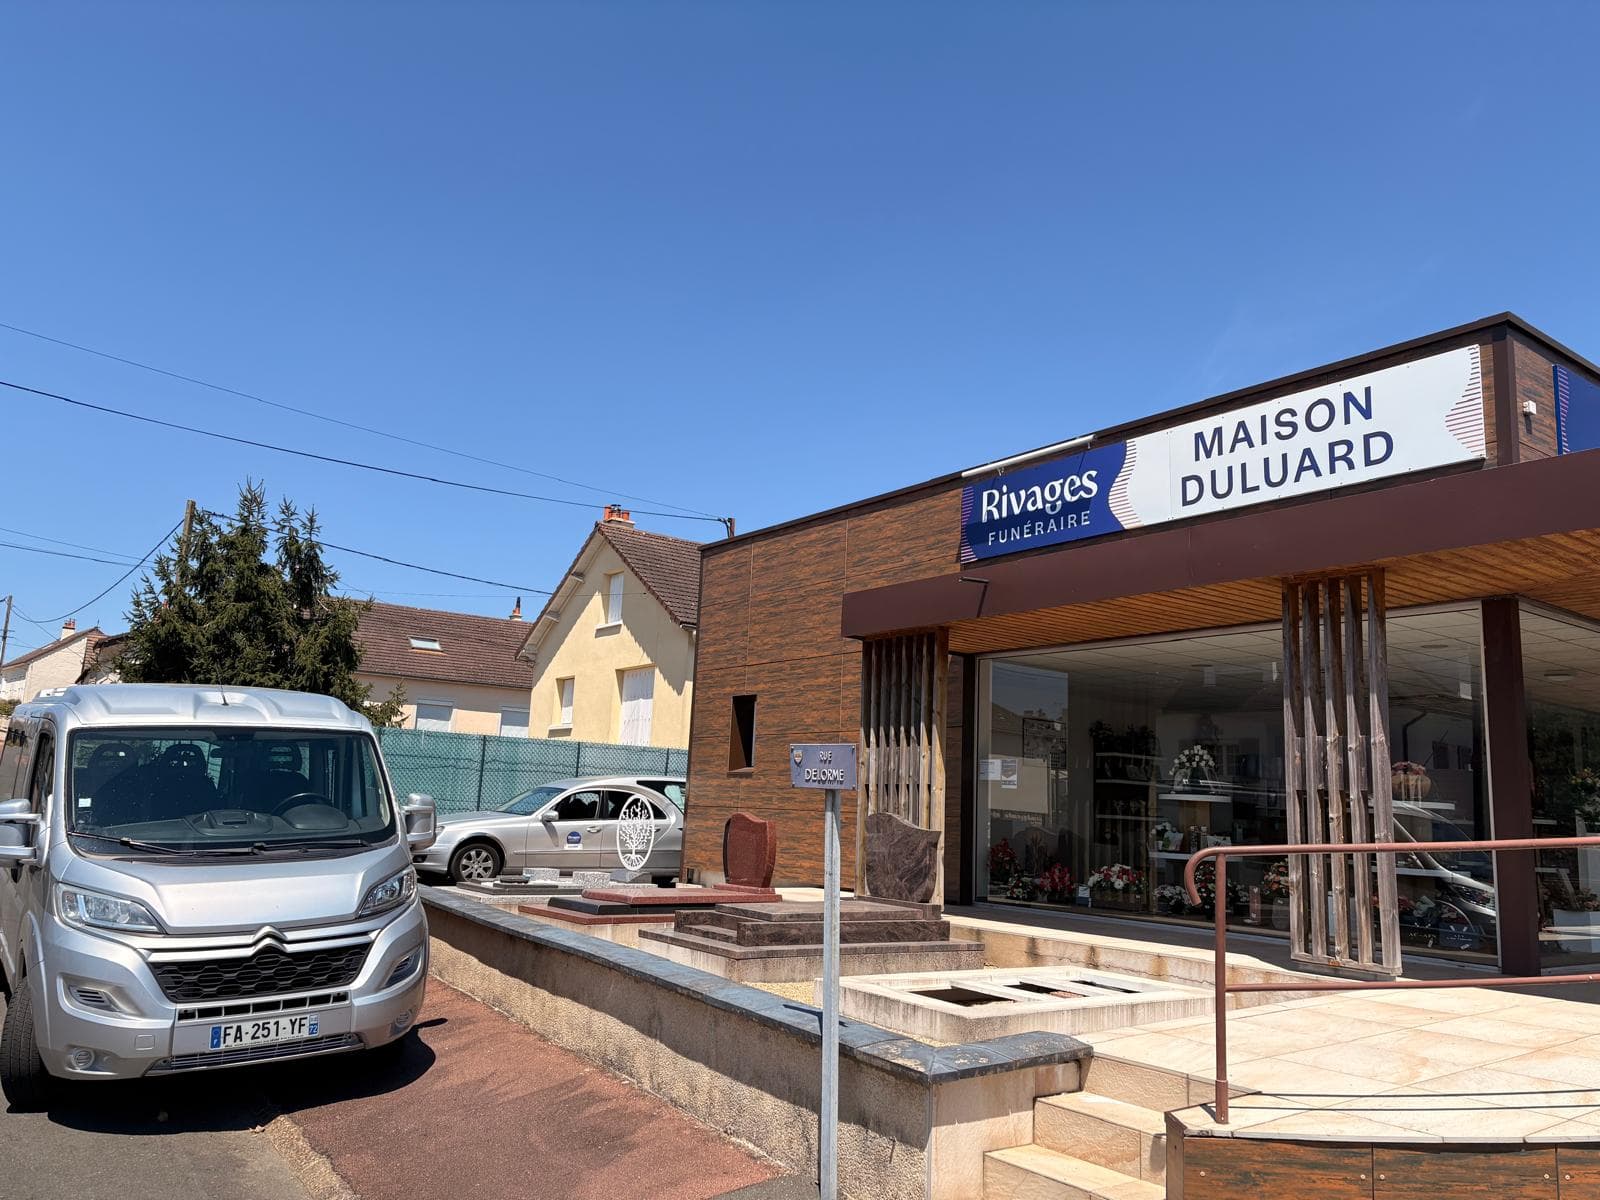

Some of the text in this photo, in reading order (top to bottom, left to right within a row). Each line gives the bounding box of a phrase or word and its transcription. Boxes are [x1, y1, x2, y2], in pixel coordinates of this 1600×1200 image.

[1193, 386, 1373, 462] MAISON
[1181, 430, 1394, 507] DULUARD
[981, 470, 1099, 523] Rivages
[988, 510, 1091, 546] FUNÉRAIRE
[819, 751, 833, 761] RUE
[804, 768, 845, 781] DELORME
[223, 1016, 308, 1045] FA-251-YF
[308, 1024, 318, 1035] 72
